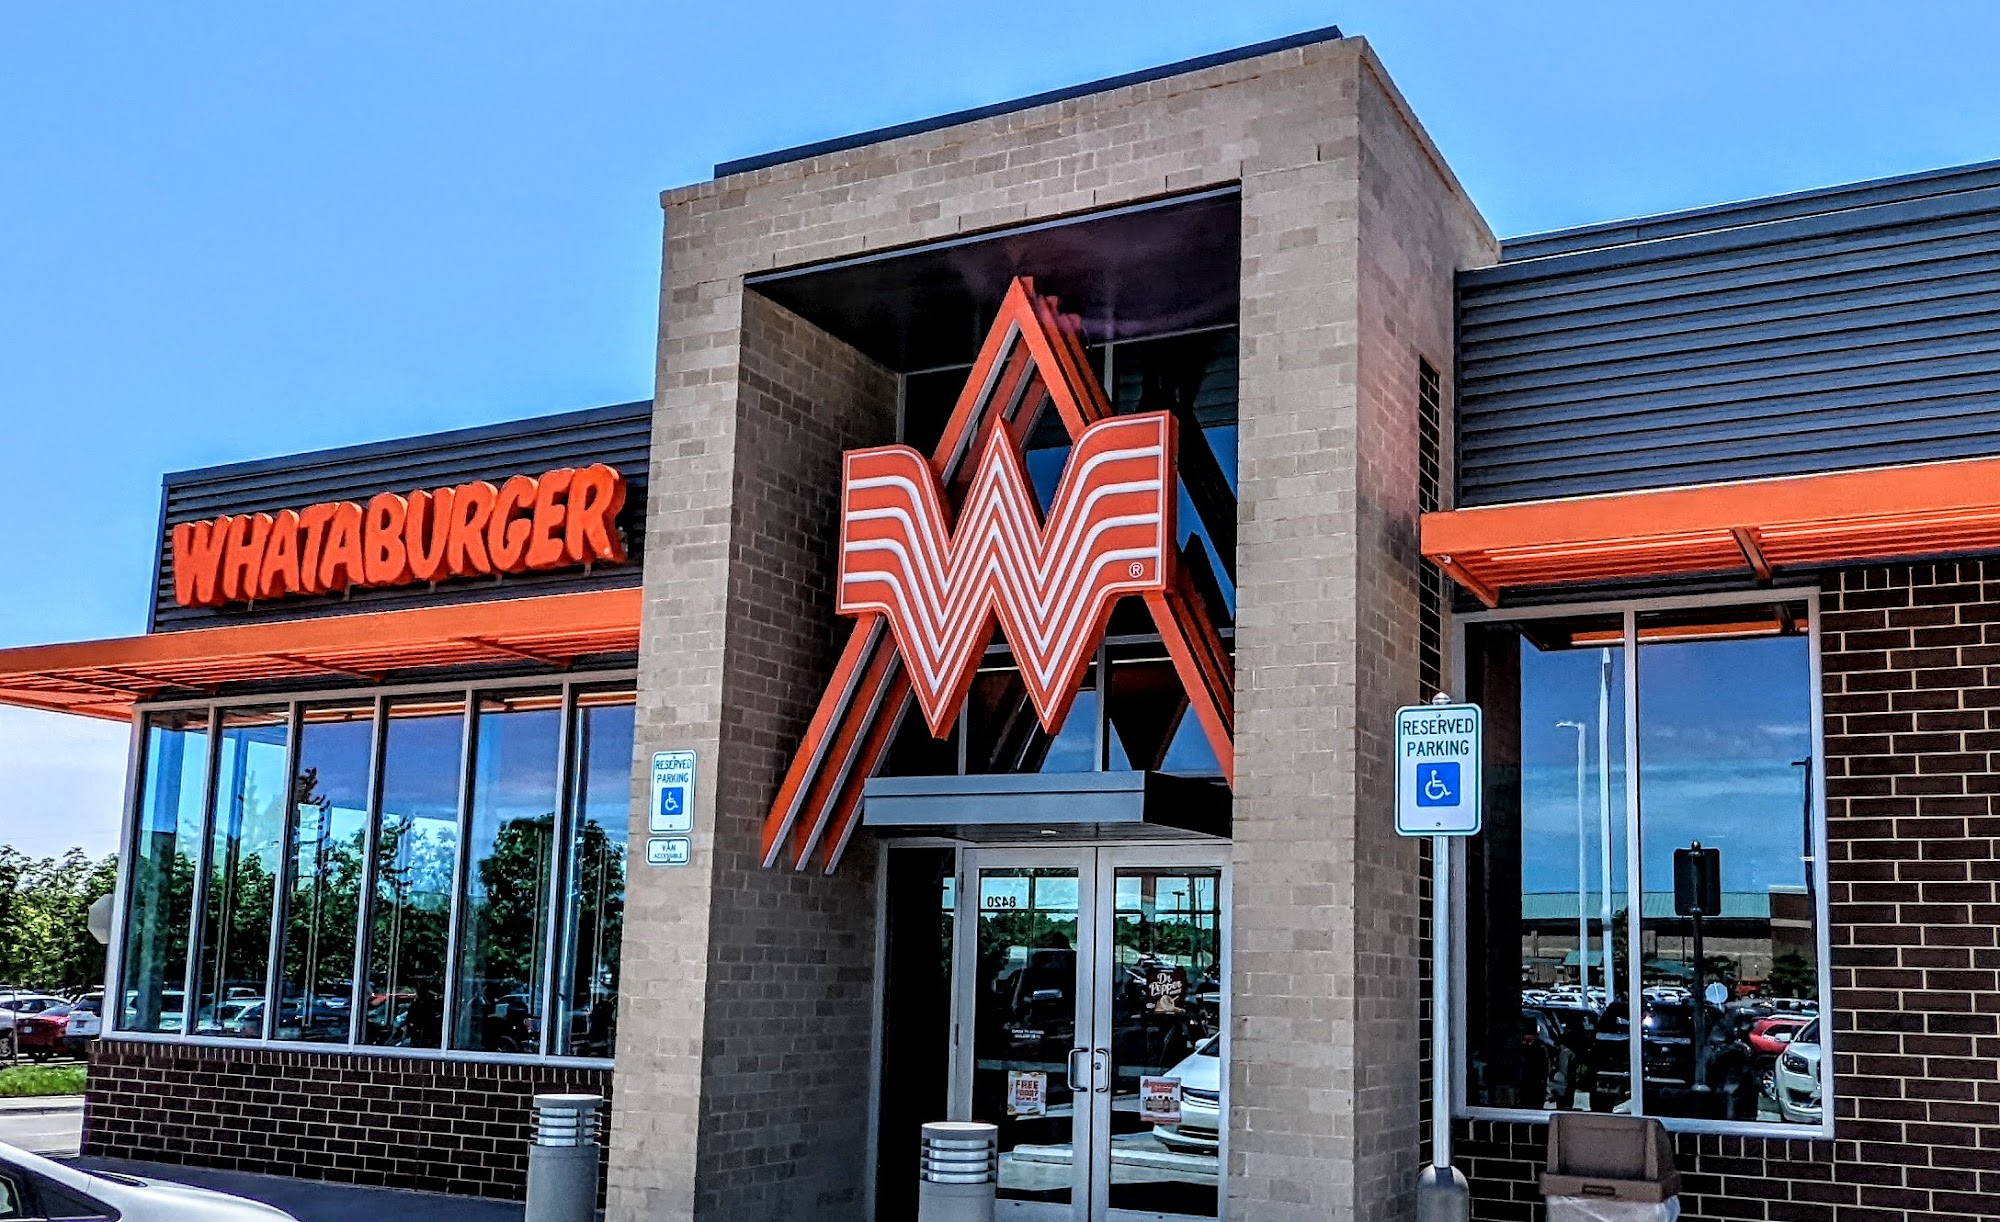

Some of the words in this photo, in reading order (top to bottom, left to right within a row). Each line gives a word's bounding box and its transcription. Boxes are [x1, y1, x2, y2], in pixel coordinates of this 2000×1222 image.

[171, 463, 627, 608] WHATABURGER
[1402, 718, 1474, 736] RESERVED
[1406, 740, 1470, 757] PARKING
[655, 759, 692, 770] RESERVED
[656, 773, 689, 784] PARKING
[661, 843, 676, 852] VAN
[1157, 972, 1173, 984] Dr
[1149, 980, 1183, 996] Pepper
